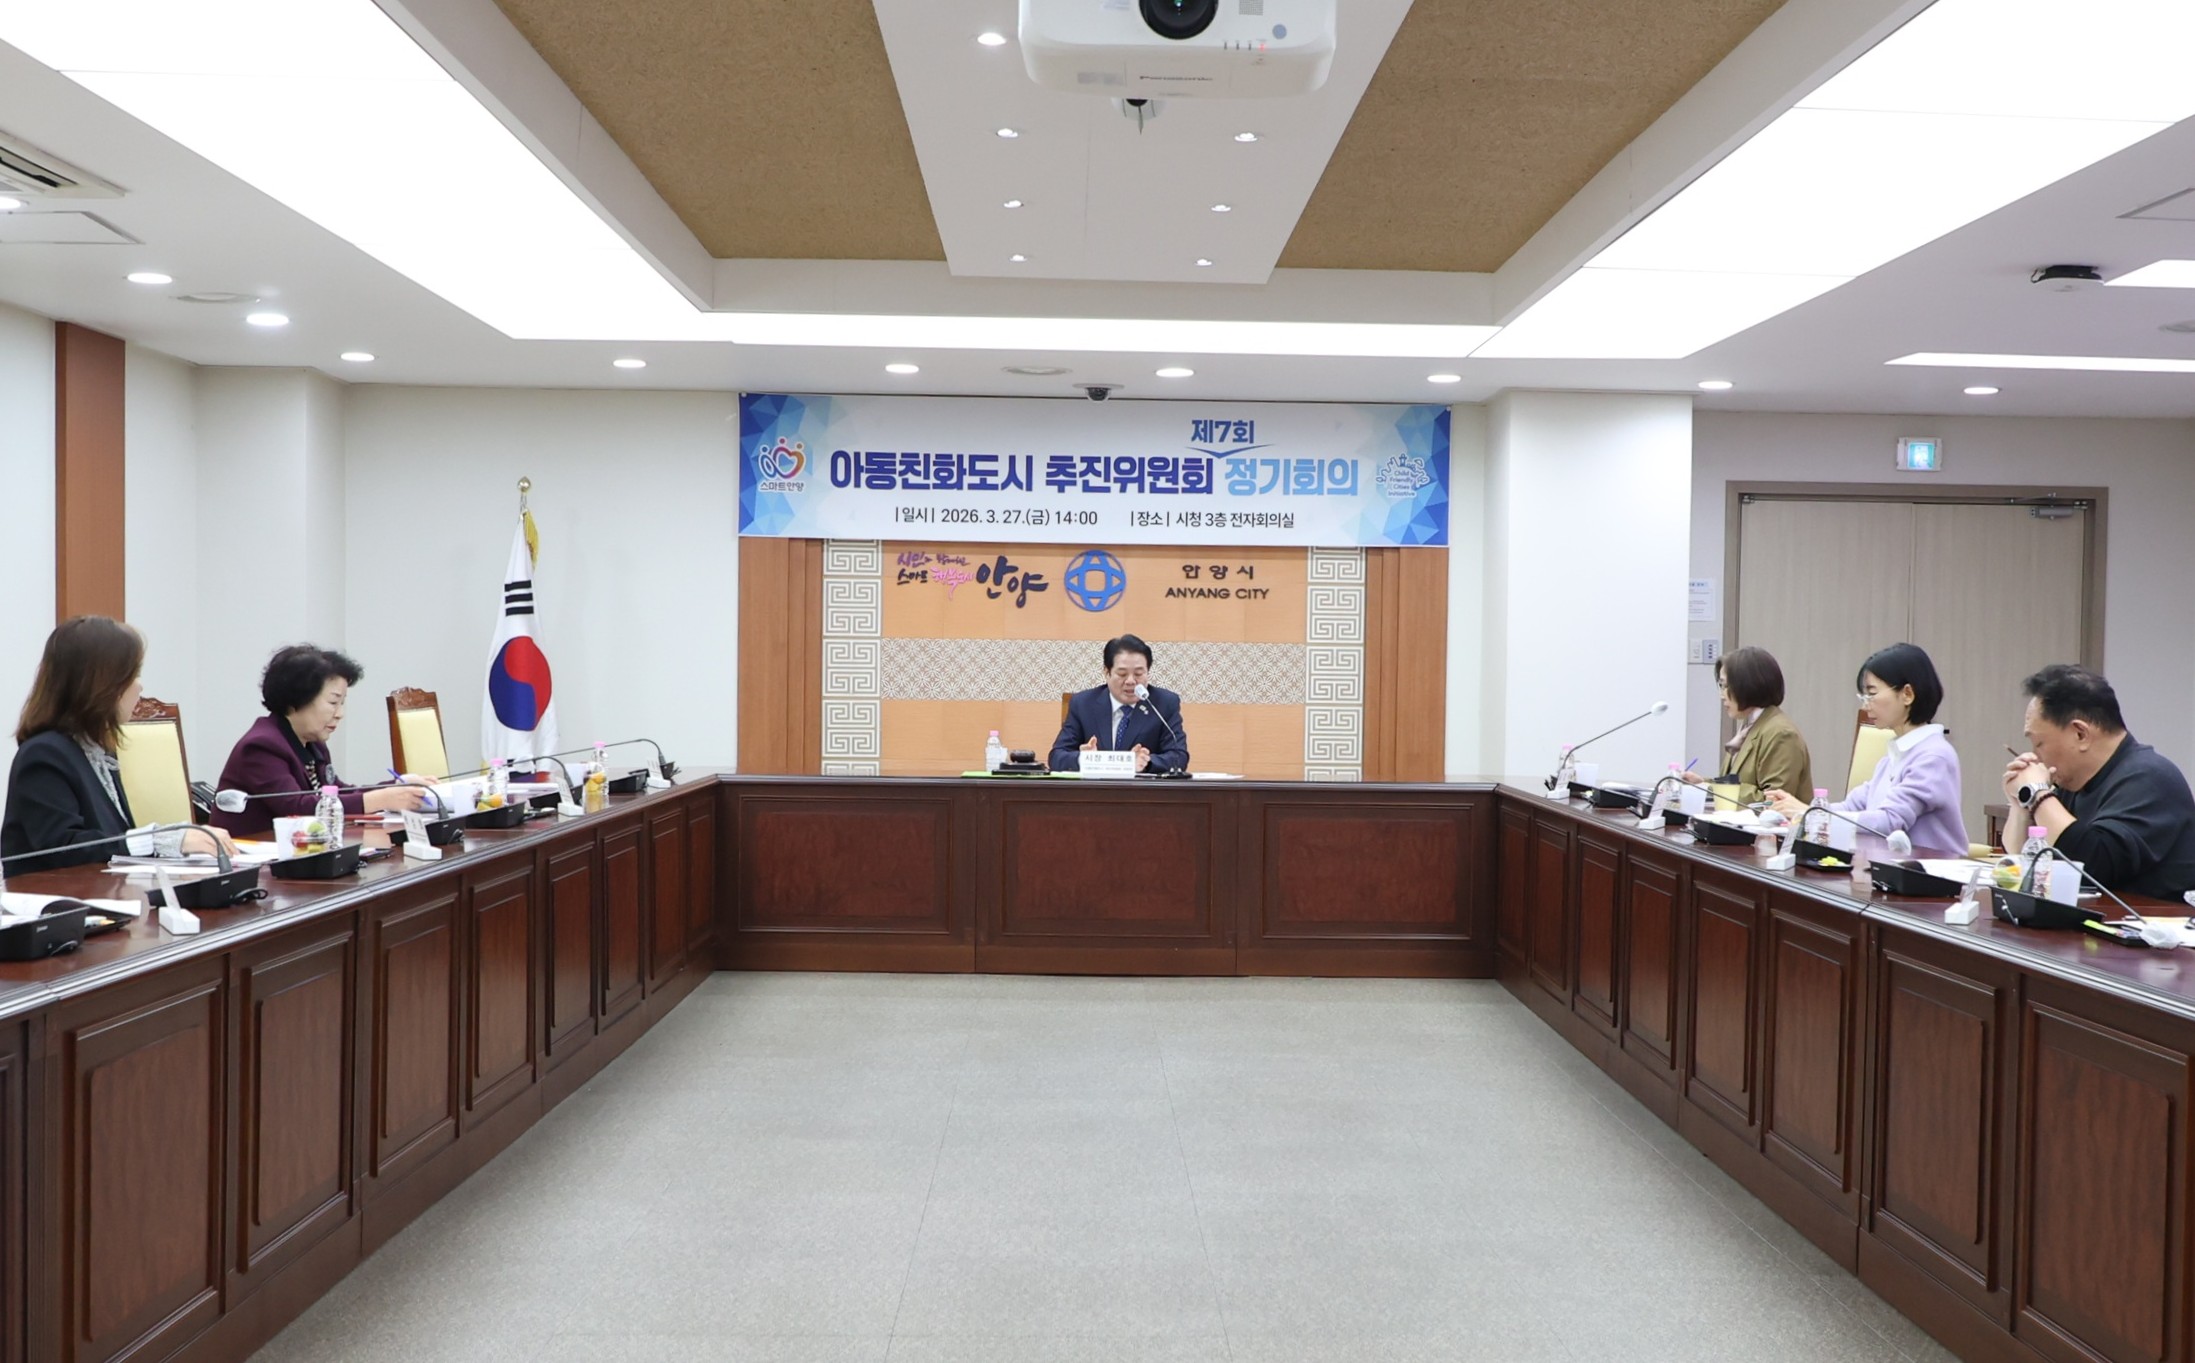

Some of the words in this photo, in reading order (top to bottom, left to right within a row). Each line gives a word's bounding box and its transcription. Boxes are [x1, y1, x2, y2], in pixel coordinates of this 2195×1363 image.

[1191, 419, 1255, 444] 제7회
[830, 450, 1033, 493] 아동친화도시
[1045, 454, 1214, 496] 추진위원회
[1224, 457, 1359, 497] 정기회의
[760, 481, 804, 492] 스마트안양
[1055, 510, 1097, 525] 14:00
[1176, 511, 1202, 528] 시청
[1205, 512, 1228, 528] 3층
[1230, 512, 1295, 529] 전자회의실
[975, 555, 1049, 608] 안양
[1165, 587, 1231, 600] ANYANG
[1235, 588, 1270, 600] CITY
